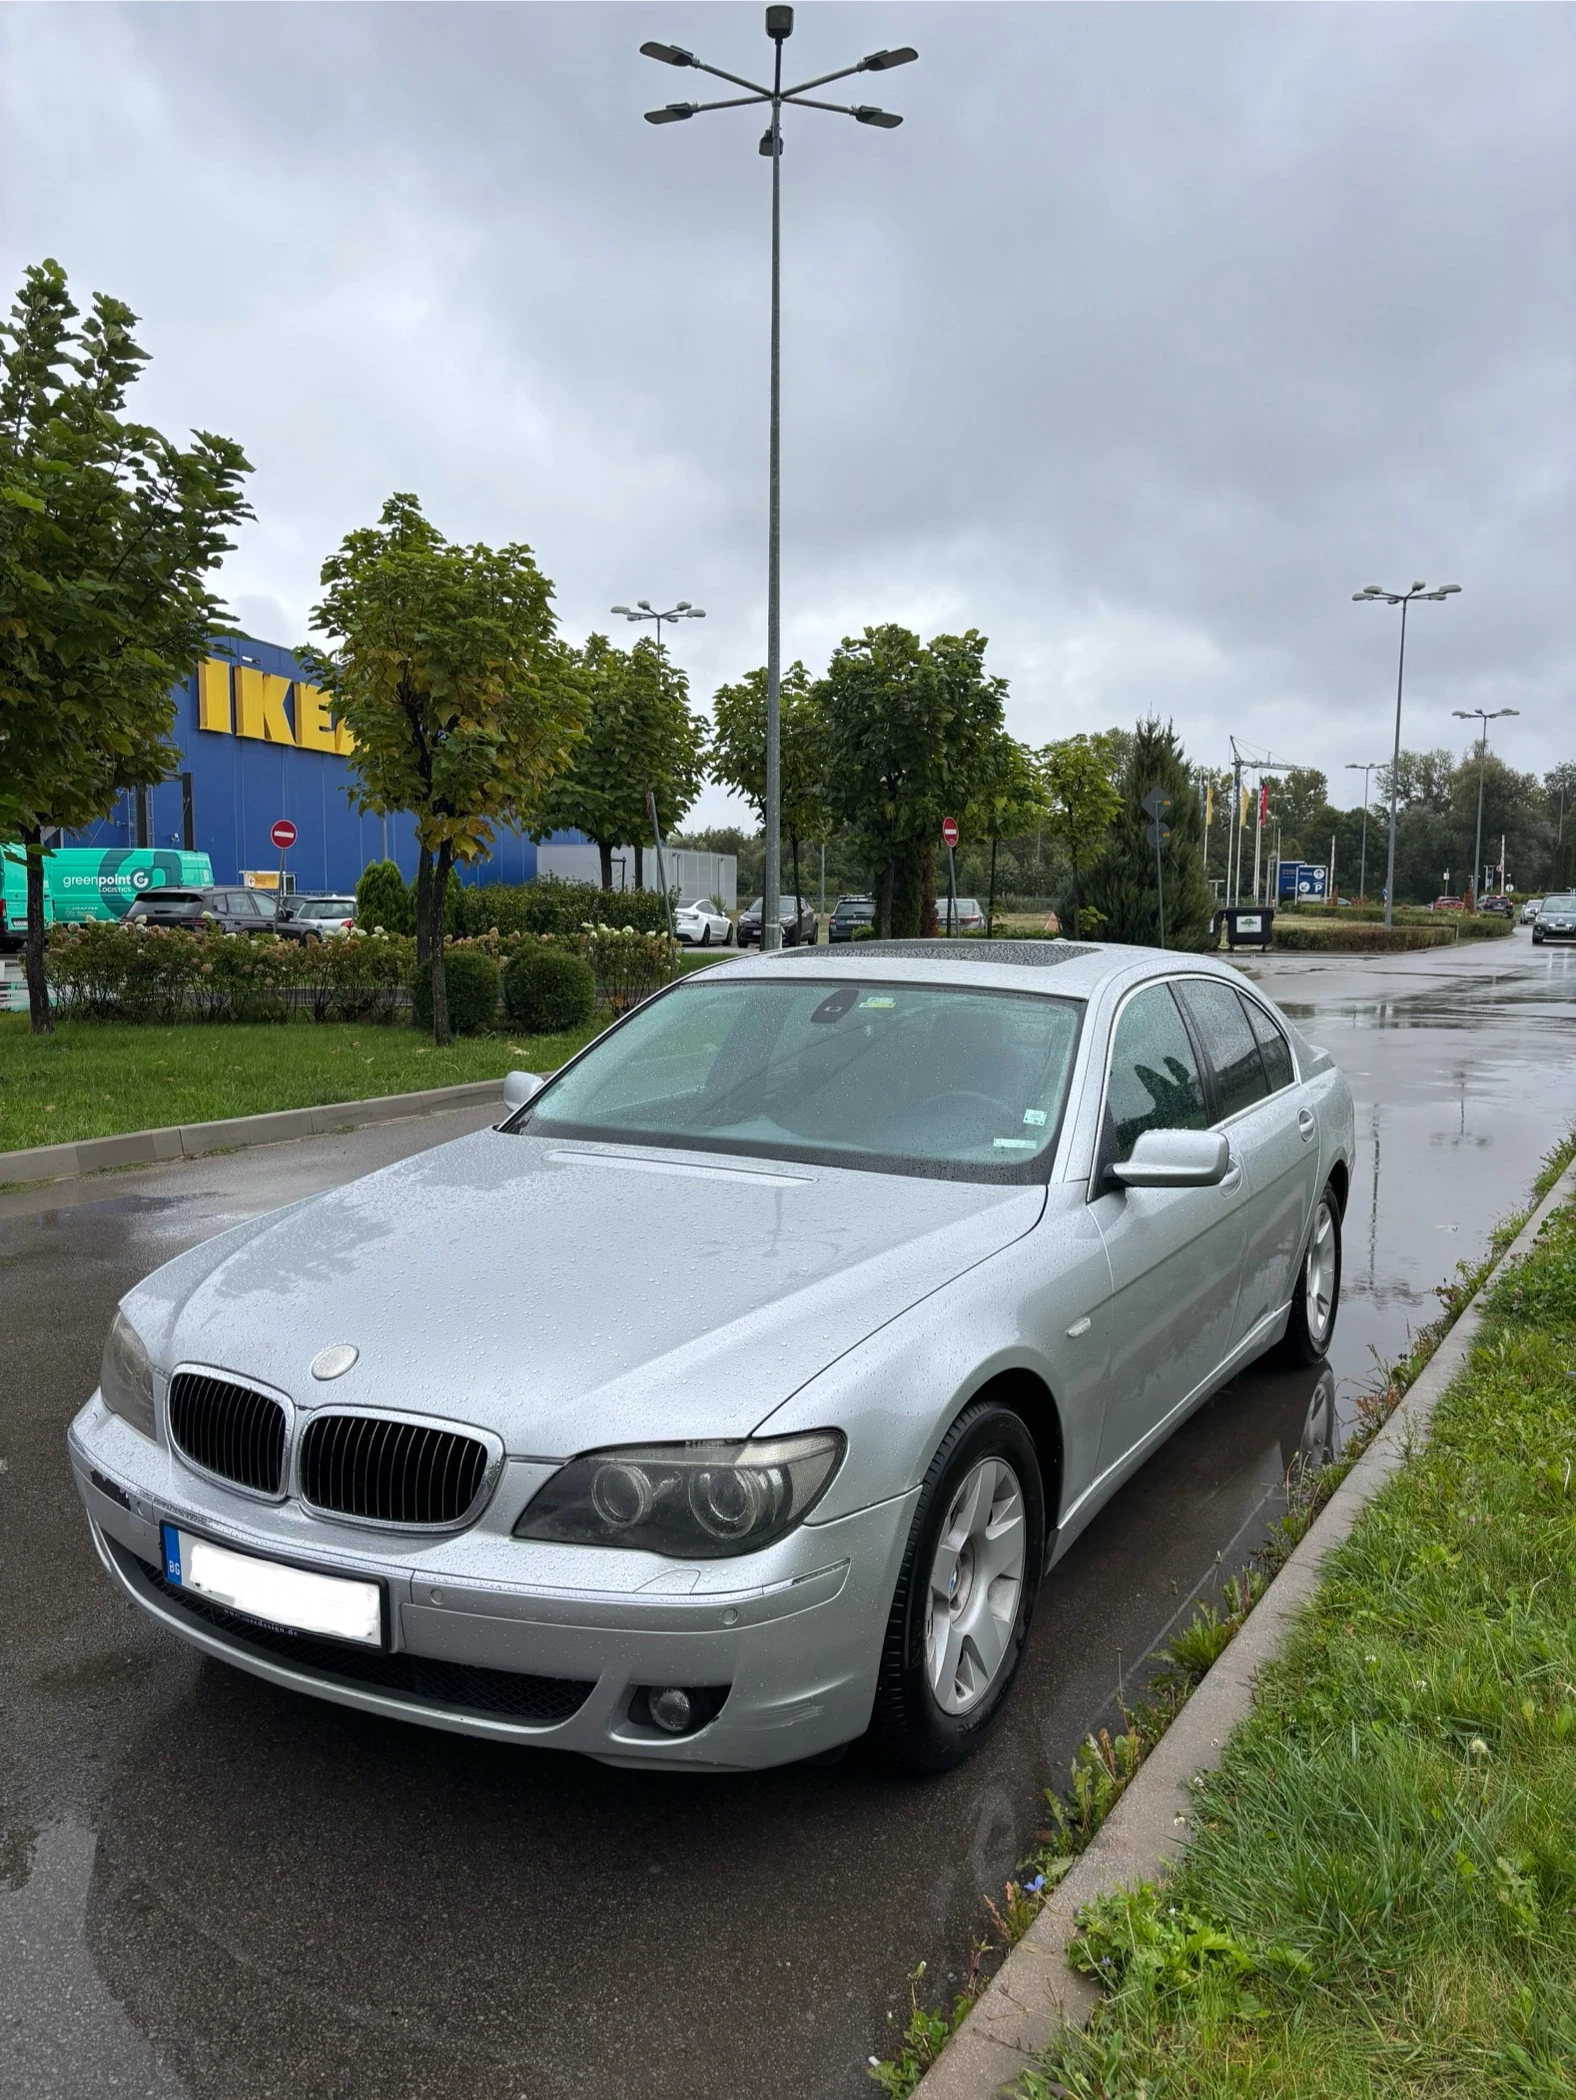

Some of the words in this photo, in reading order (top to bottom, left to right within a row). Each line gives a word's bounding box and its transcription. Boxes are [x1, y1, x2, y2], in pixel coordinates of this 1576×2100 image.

[63, 874, 131, 888] greenpoint
[1315, 884, 1323, 893] P
[169, 1560, 180, 1576] BG
